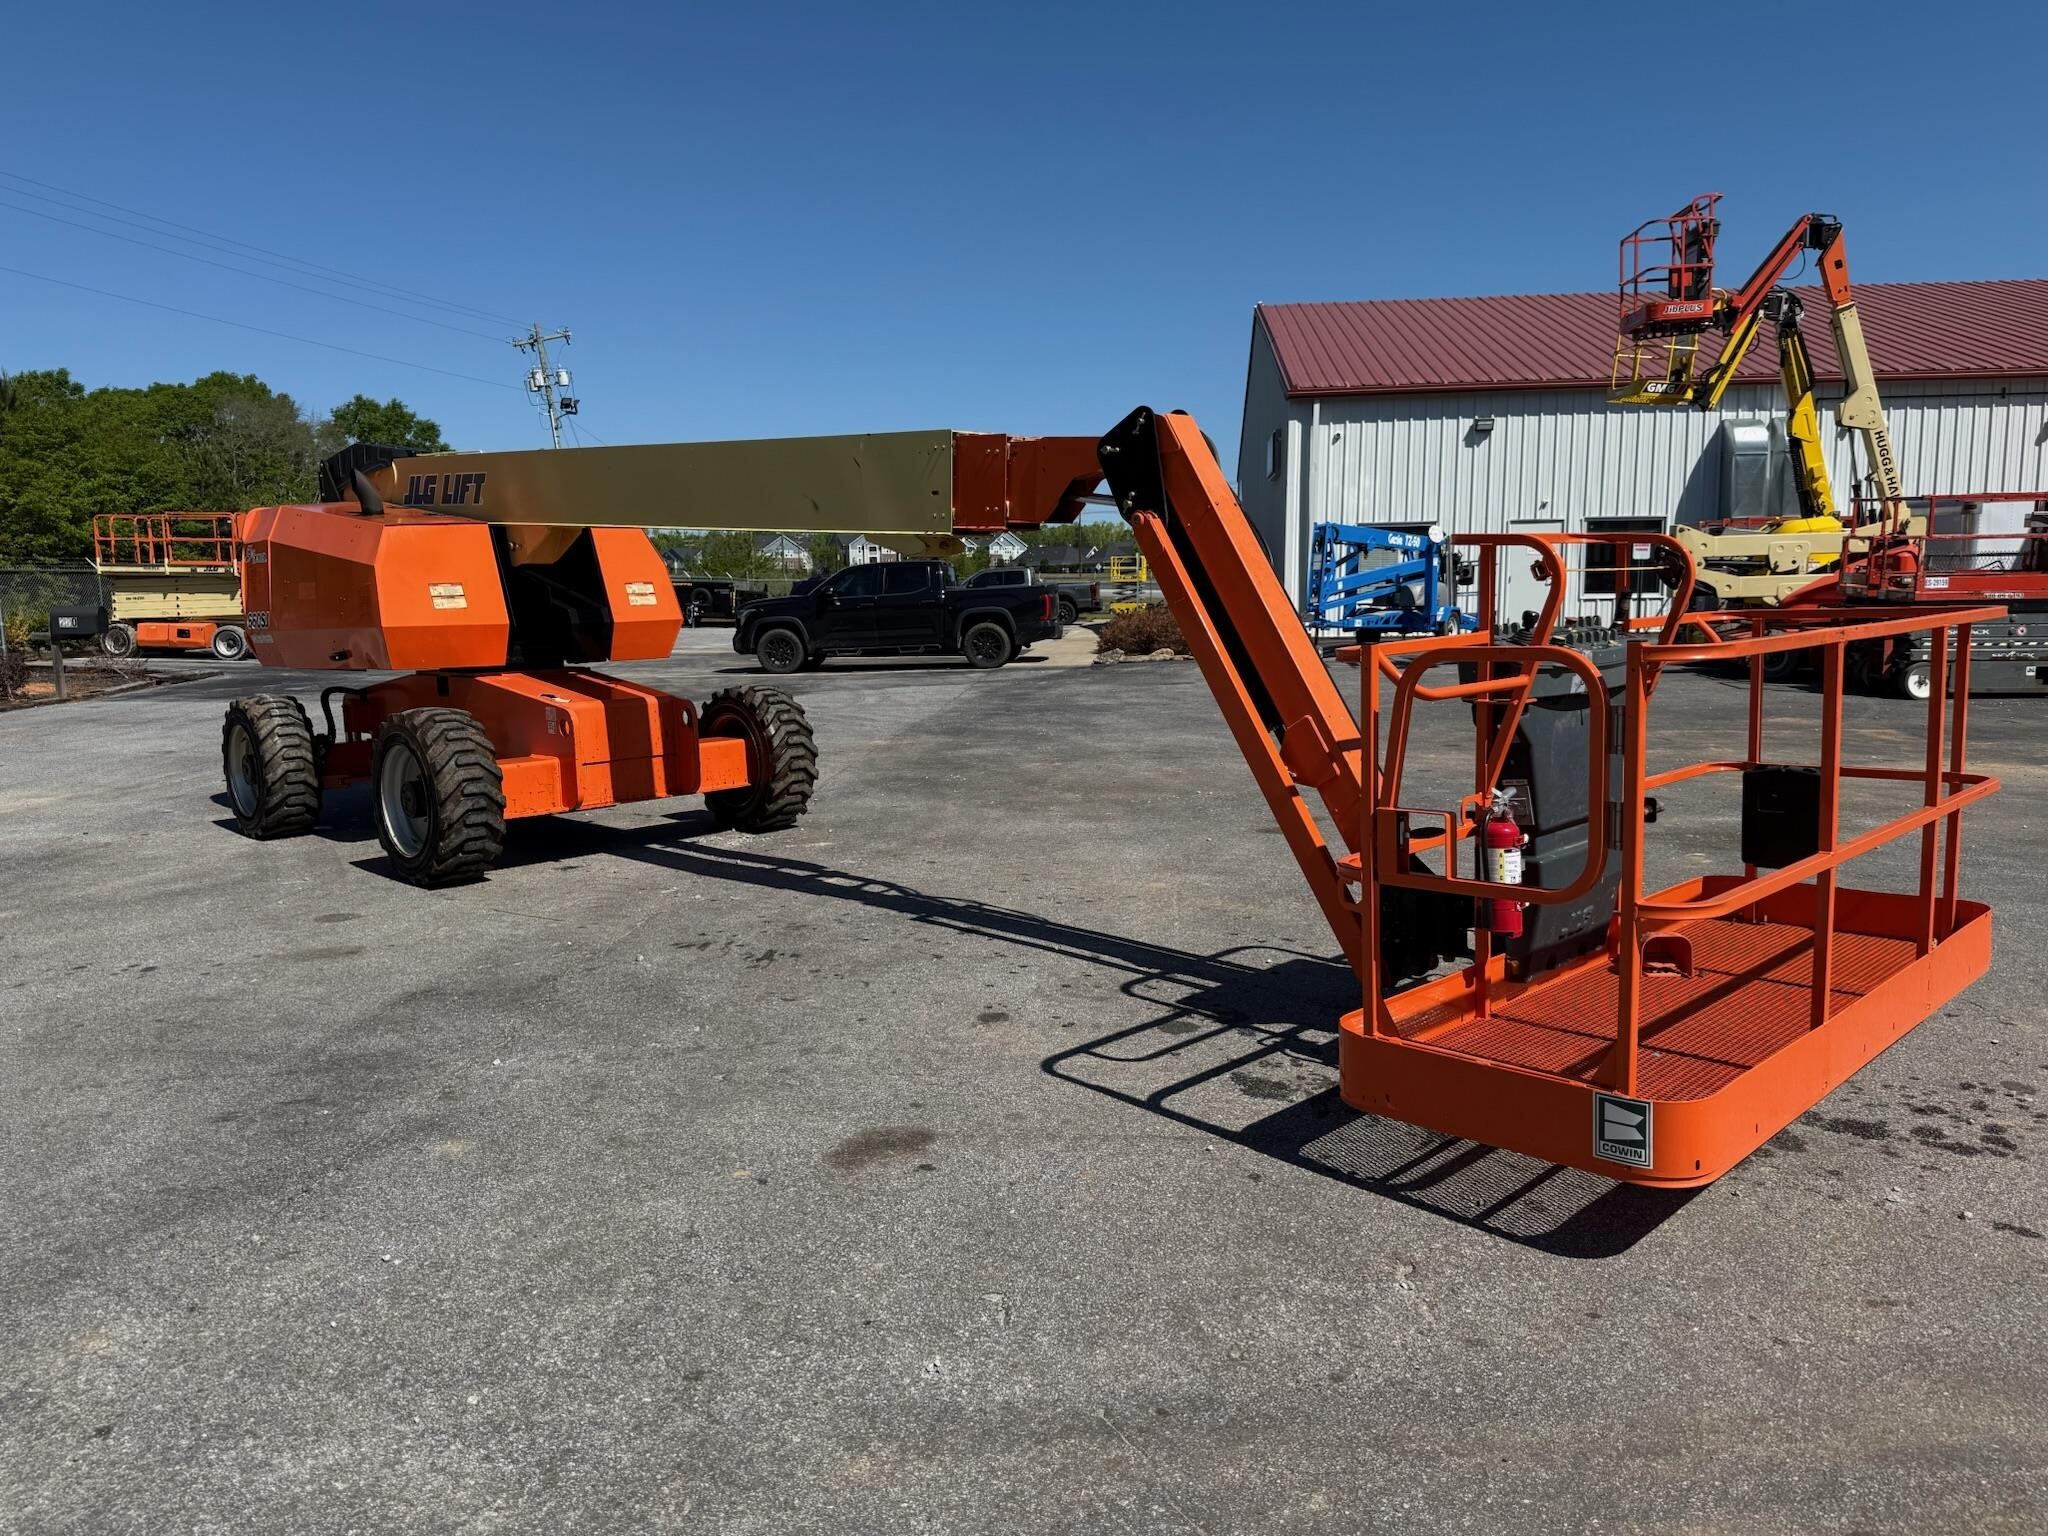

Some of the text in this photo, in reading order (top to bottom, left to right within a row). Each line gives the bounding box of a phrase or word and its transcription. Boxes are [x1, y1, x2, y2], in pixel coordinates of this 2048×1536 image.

[1647, 383, 1675, 393] GMG
[1874, 430, 1892, 467] HUGG
[1884, 467, 1893, 476] &
[403, 472, 487, 505] JLG LIFT
[1602, 1143, 1643, 1159] COWIN
